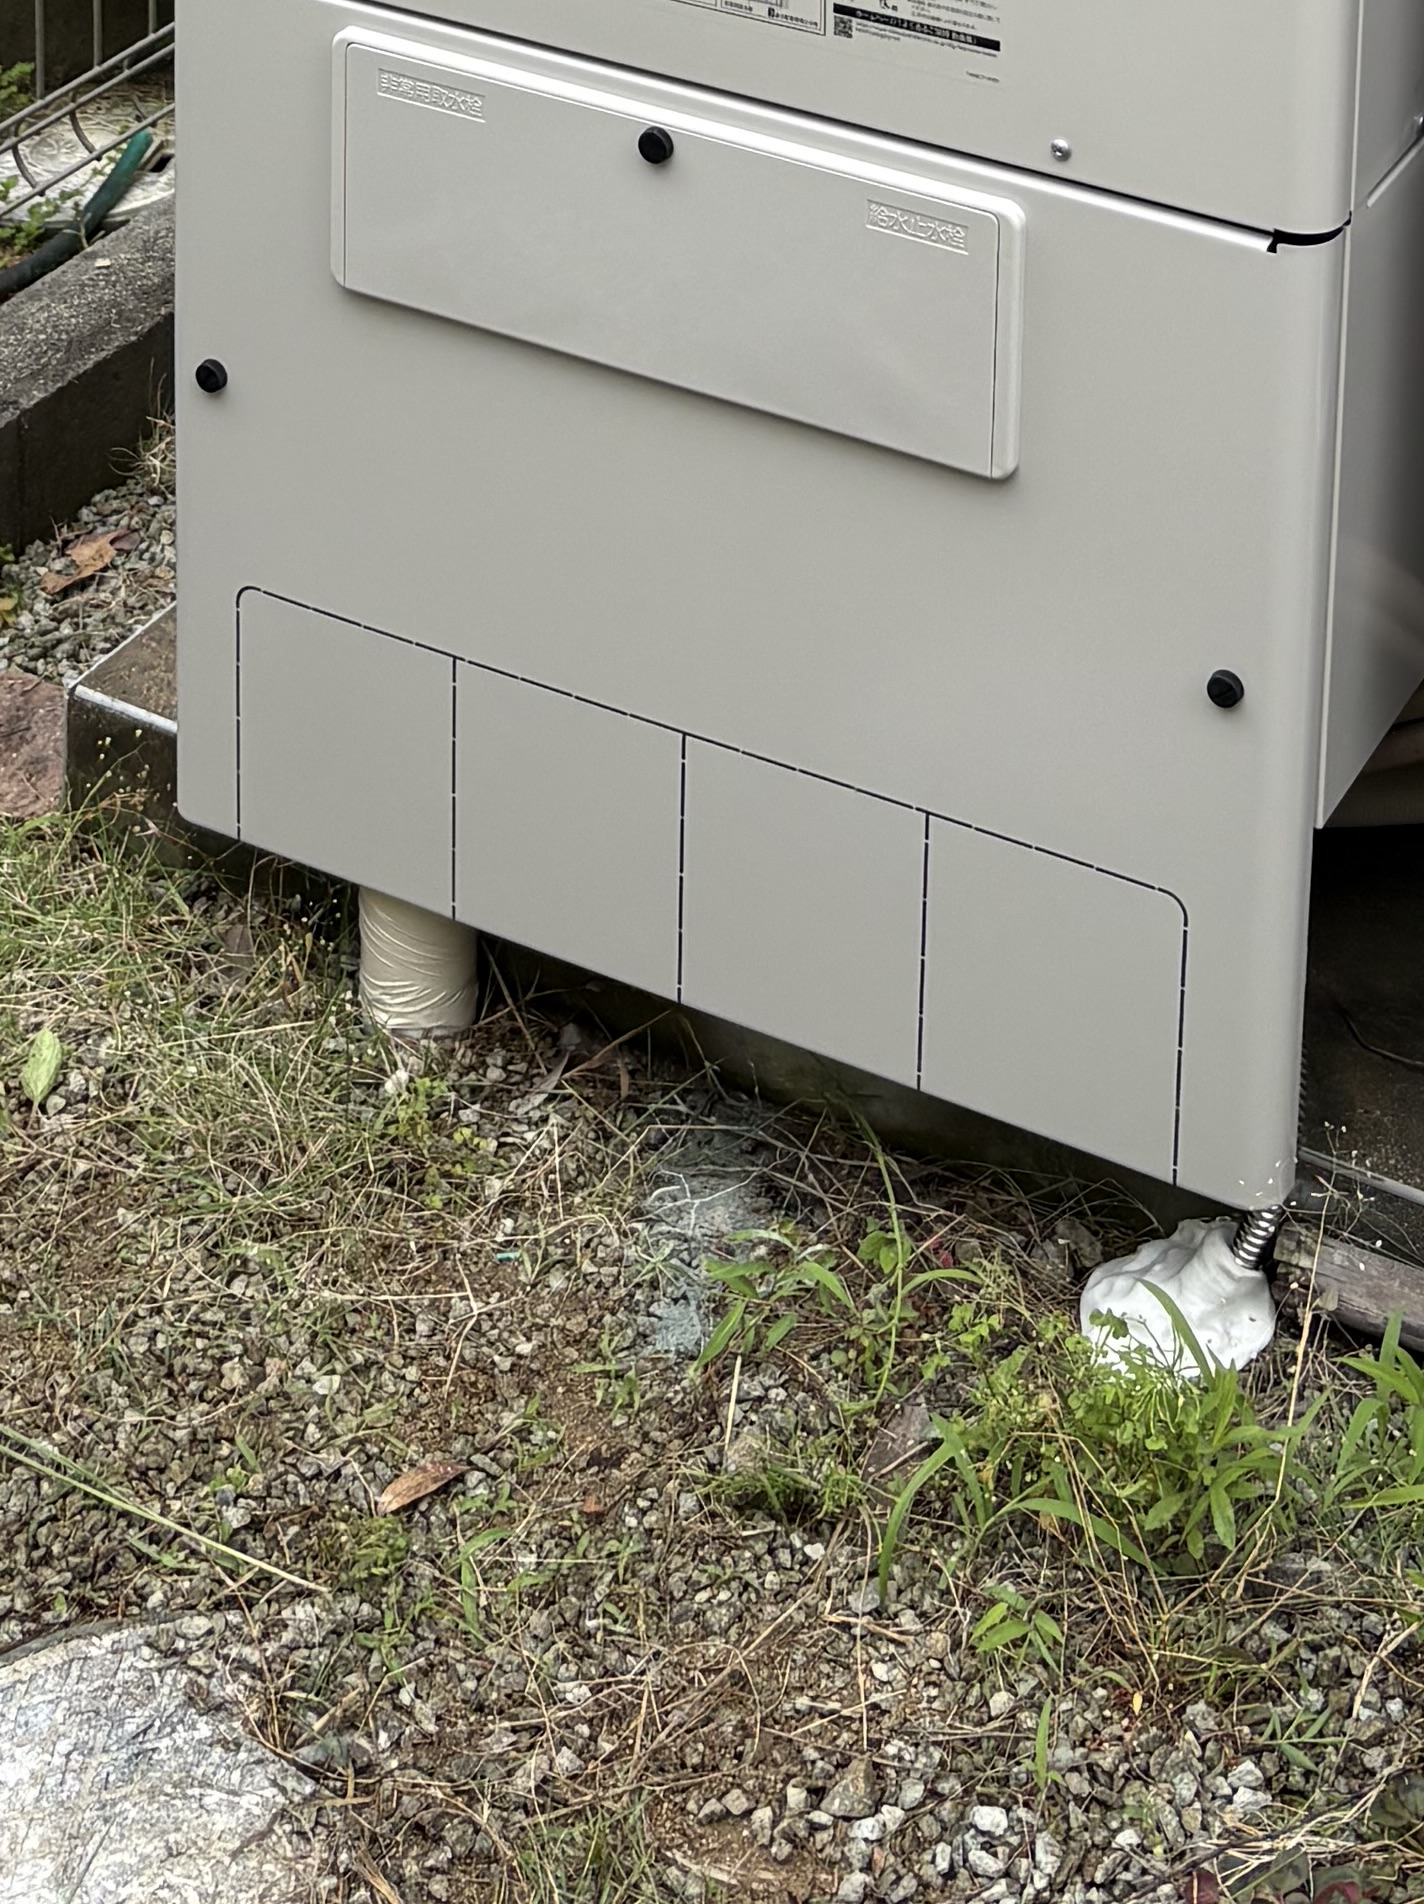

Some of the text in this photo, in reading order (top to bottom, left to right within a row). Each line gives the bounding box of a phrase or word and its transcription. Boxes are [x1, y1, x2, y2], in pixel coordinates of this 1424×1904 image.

[380, 73, 483, 117] 非常用取水栓
[869, 203, 965, 248] 給水止水栓
